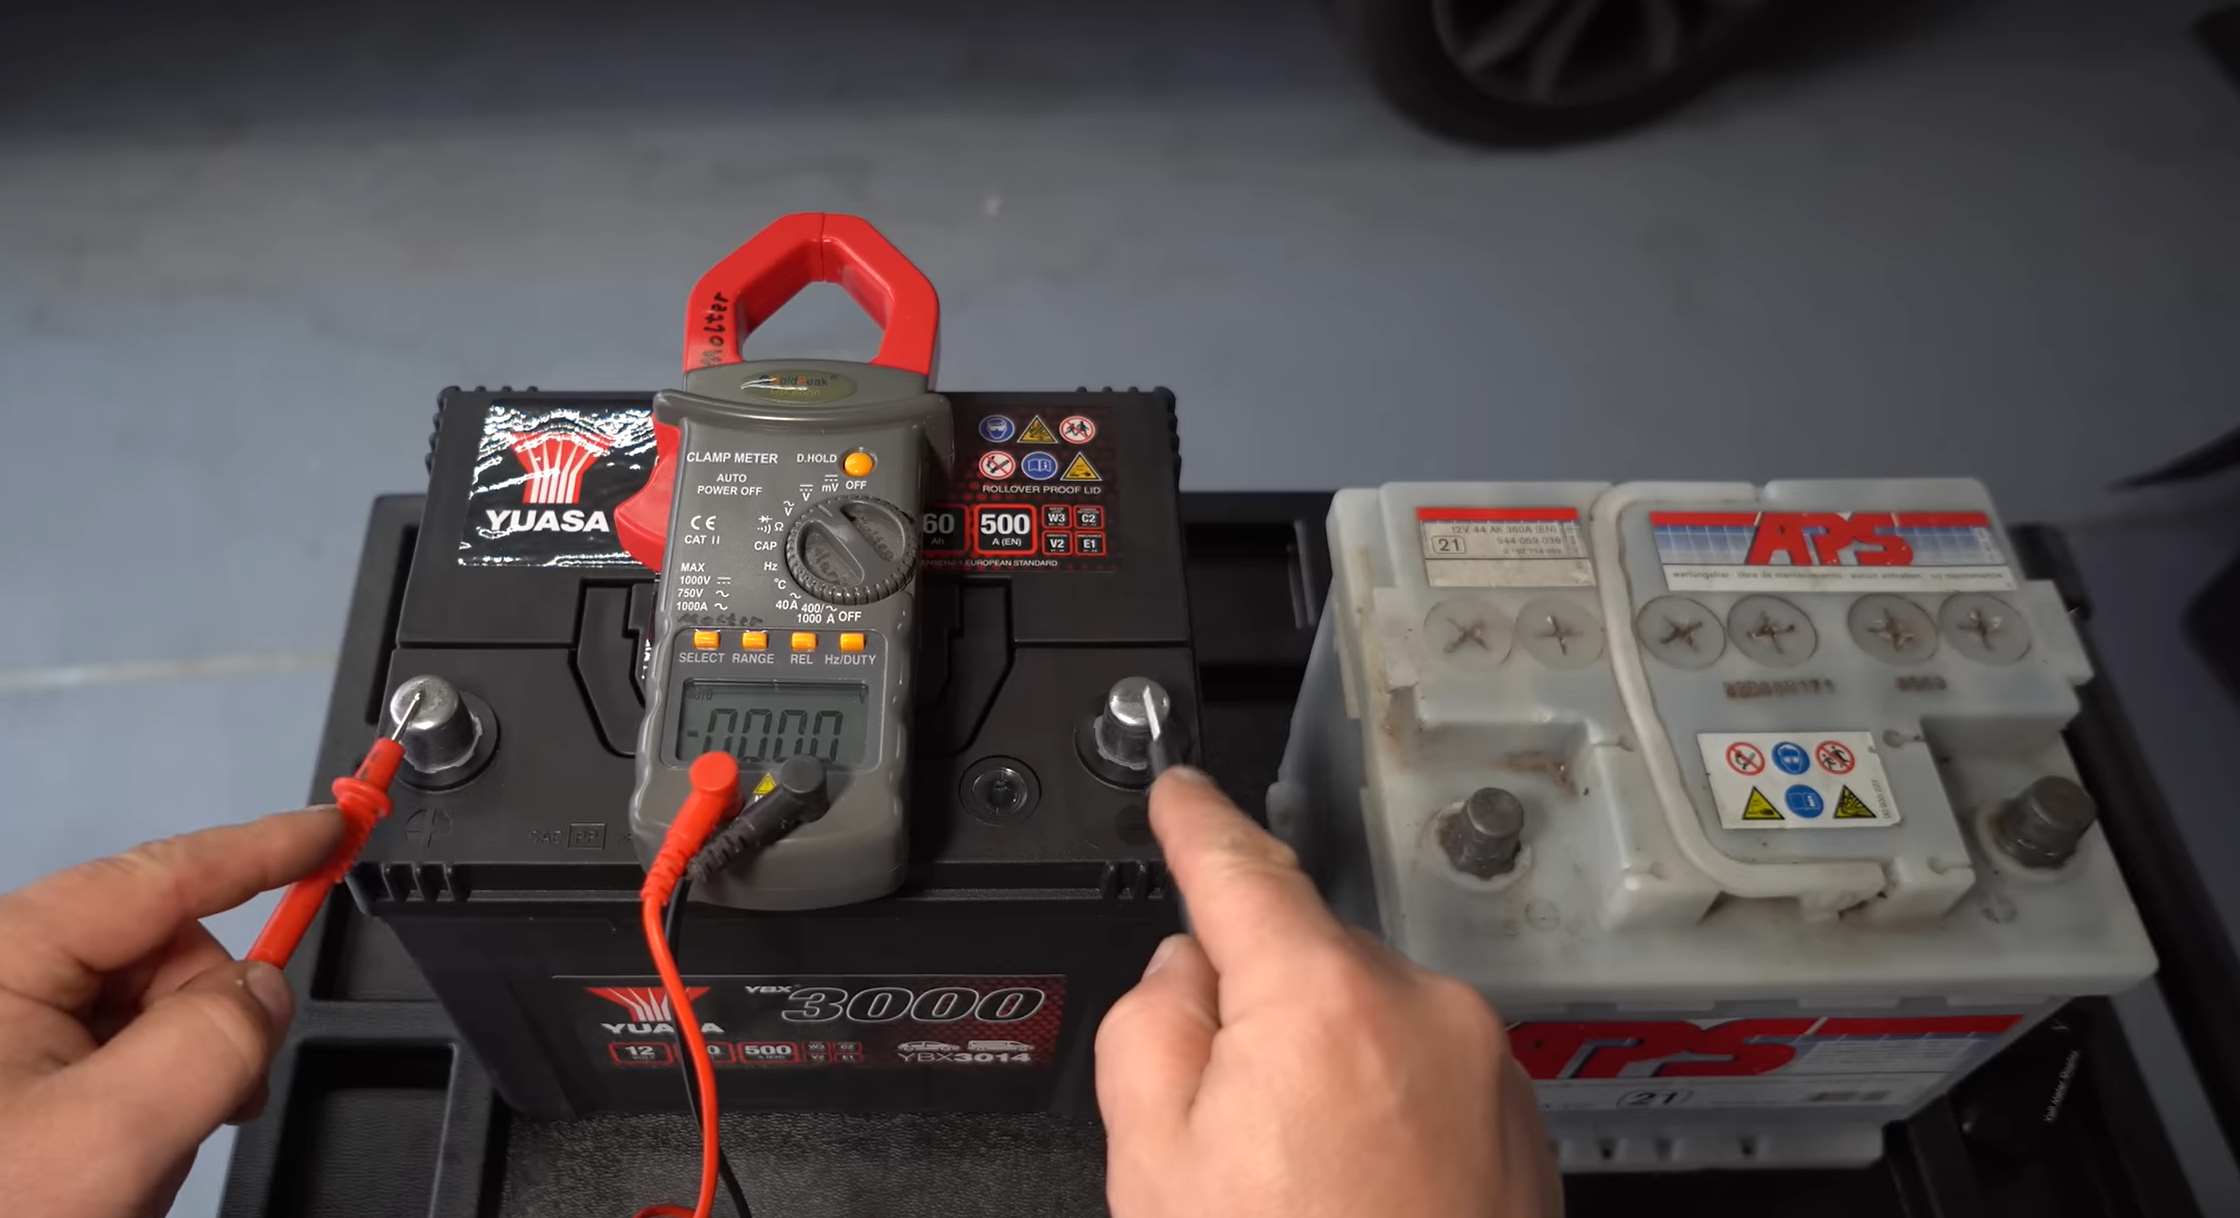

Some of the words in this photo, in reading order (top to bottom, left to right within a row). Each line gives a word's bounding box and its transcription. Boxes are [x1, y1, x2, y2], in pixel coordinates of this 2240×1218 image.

[686, 452, 731, 463] CLAMP
[734, 453, 778, 464] METER
[796, 453, 837, 463] D.HOLD
[716, 473, 747, 483] AUTO
[697, 485, 738, 495] POWER
[740, 486, 763, 496] OFF
[822, 483, 839, 493] mV
[845, 481, 867, 490] OFF
[983, 485, 1040, 494] ROLLOVER
[1043, 485, 1081, 494] PROOF
[1084, 486, 1102, 494] LID
[802, 492, 810, 501] V
[784, 507, 792, 516] V
[486, 510, 610, 532] YUASA
[1048, 513, 1065, 522] W3
[1081, 514, 1096, 523] C2
[923, 514, 955, 534] 60
[980, 513, 1030, 535] 500
[684, 535, 707, 545] CAT
[992, 538, 1000, 546] A
[1002, 538, 1022, 547] (EN)
[1050, 538, 1065, 548] V2
[1083, 538, 1096, 548] E1
[1745, 511, 1913, 566] APS
[754, 541, 777, 551] CAP
[1438, 538, 1460, 552] 21
[681, 562, 705, 572] MAX
[764, 562, 778, 571] Hz
[966, 559, 1012, 567] EUROPEAN
[1013, 559, 1058, 567] STANDARD
[680, 575, 711, 585] 1000V
[678, 588, 704, 598] 750V
[676, 602, 708, 611] 1000A
[776, 600, 798, 610] 40A
[797, 613, 822, 623] 1000
[827, 613, 835, 623] A
[838, 612, 862, 622] OFF
[679, 653, 725, 663] SELECT
[732, 653, 774, 664] RANGE
[790, 654, 813, 664] REL
[825, 655, 876, 665] Hz/DUTY
[781, 986, 1045, 1023] 3000
[601, 1023, 725, 1034] YUAA
[625, 1046, 655, 1055] 12
[745, 1046, 792, 1055] 500
[897, 1052, 1032, 1062] YBX3014
[1627, 1091, 1678, 1106] 21
